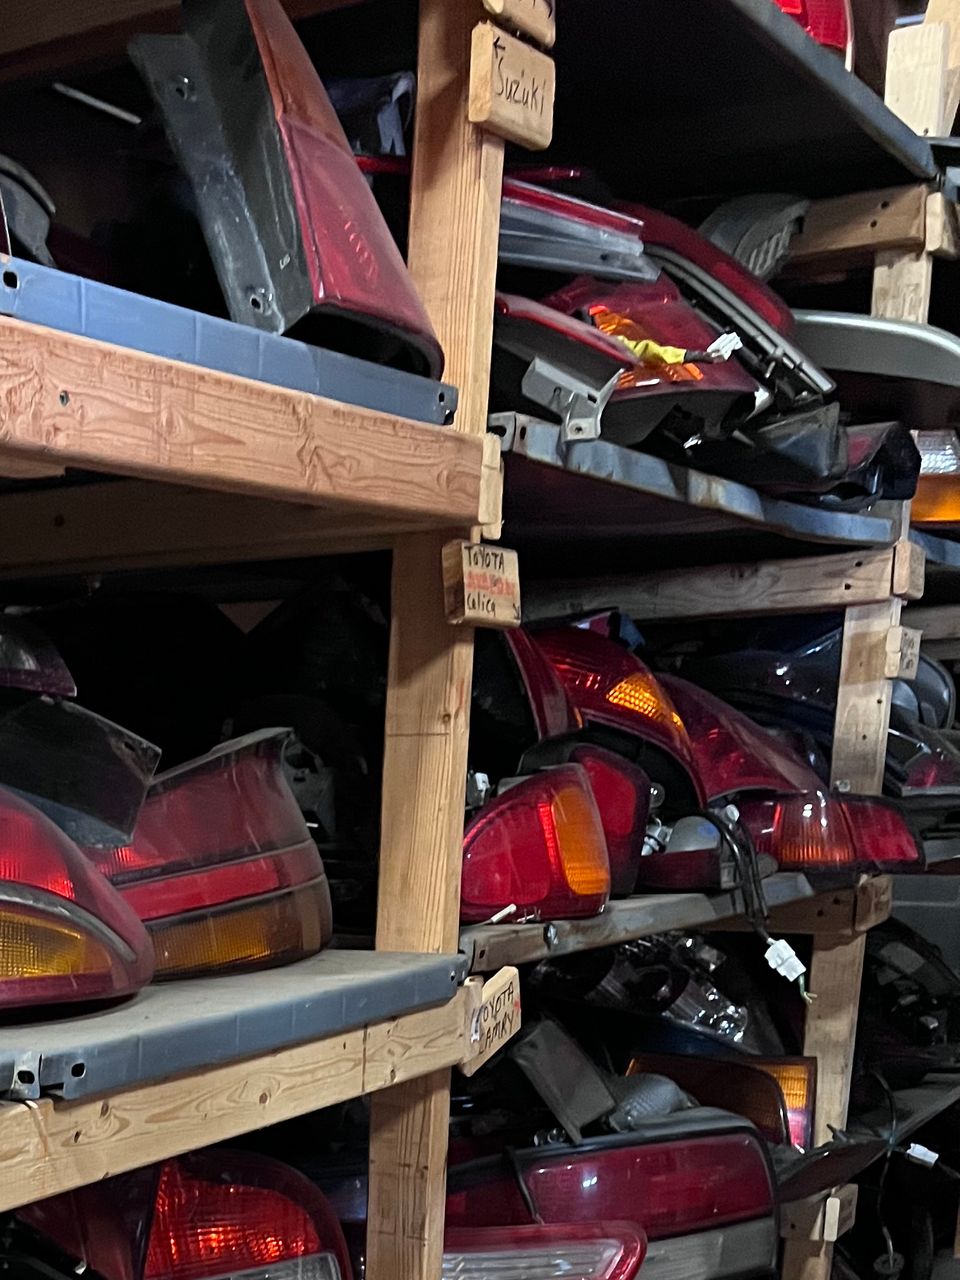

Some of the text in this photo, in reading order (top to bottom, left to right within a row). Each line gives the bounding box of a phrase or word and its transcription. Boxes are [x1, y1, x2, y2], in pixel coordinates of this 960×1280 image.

[496, 56, 547, 116] Suzuki
[464, 545, 505, 574] TOYOTA
[482, 981, 514, 1022] OYOTA
